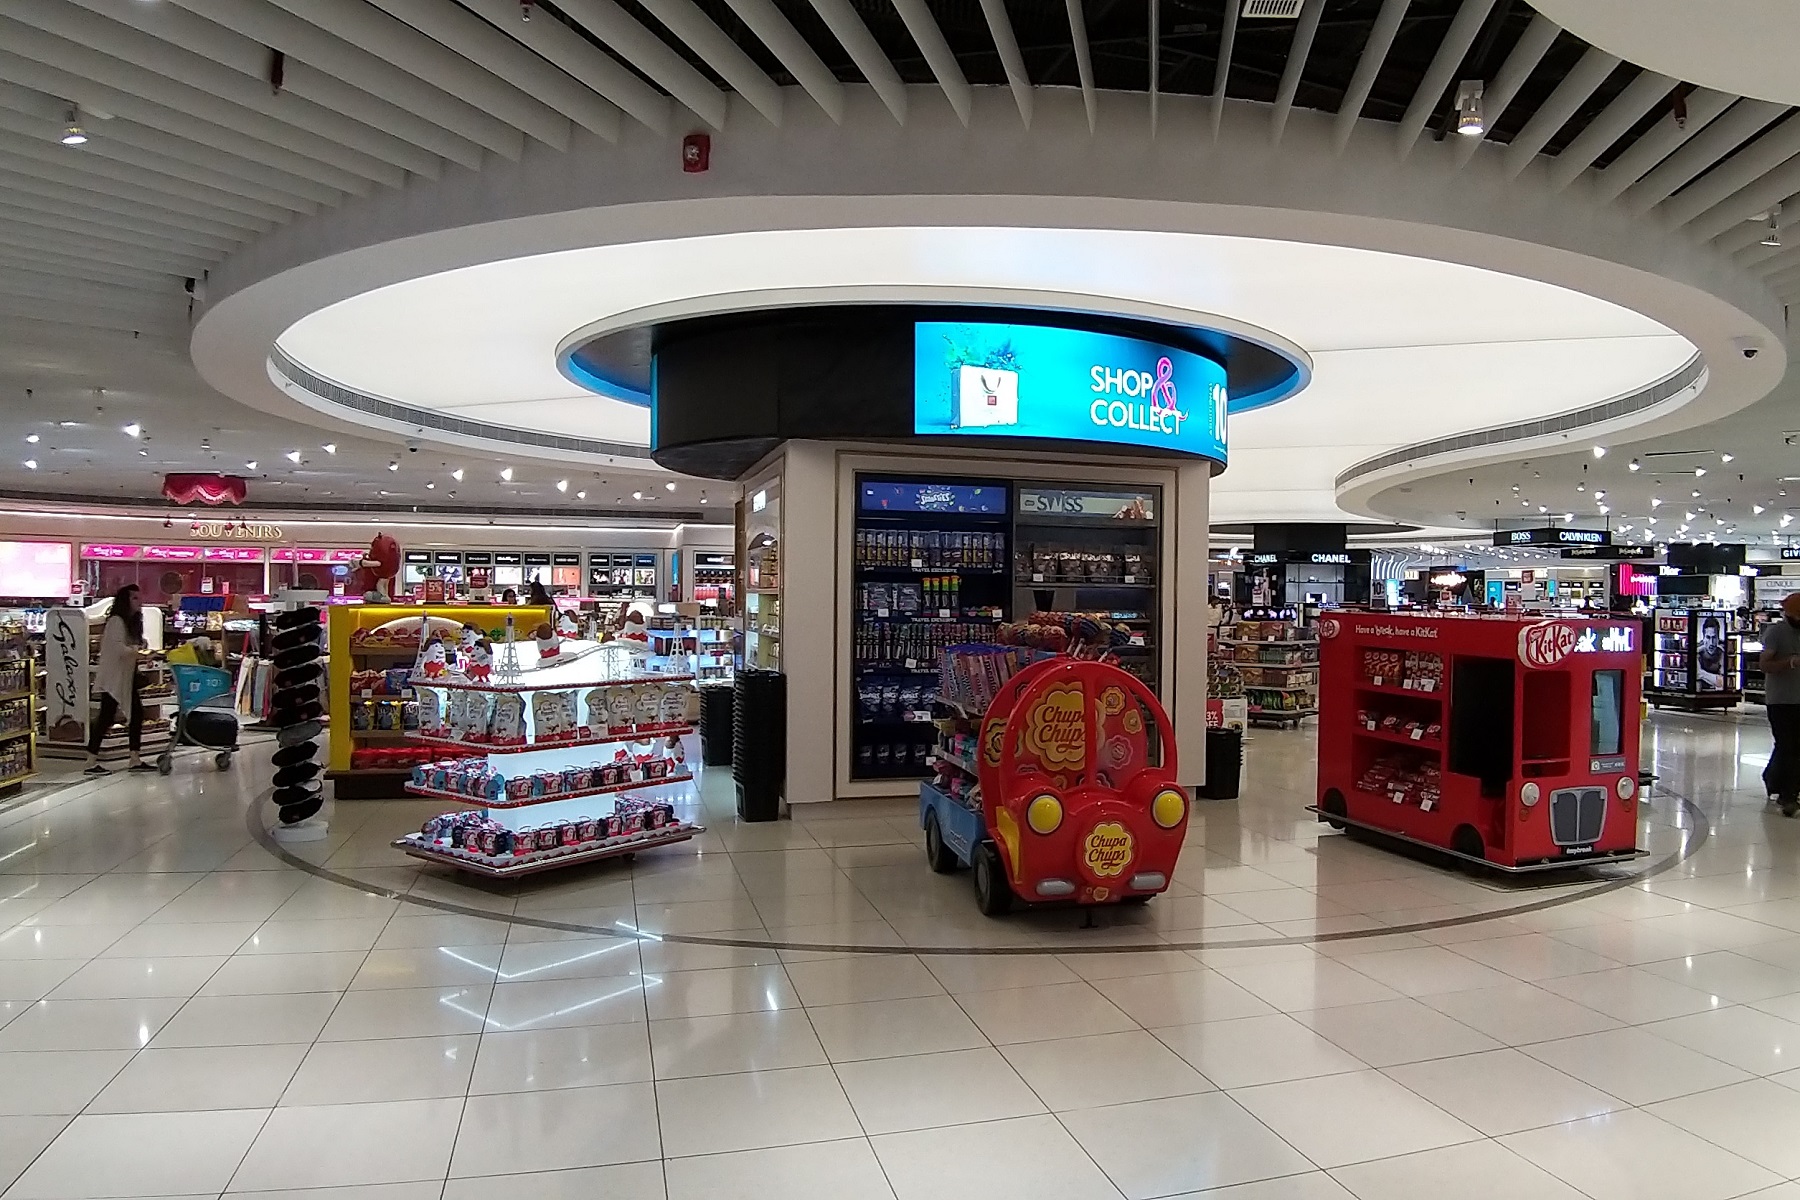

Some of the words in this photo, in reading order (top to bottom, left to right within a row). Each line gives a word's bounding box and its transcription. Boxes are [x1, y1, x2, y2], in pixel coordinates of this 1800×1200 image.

[1090, 365, 1154, 398] SHOP
[1090, 398, 1182, 436] COLLECT
[1511, 532, 1531, 541] BOSS
[1559, 531, 1584, 542] CALVIN
[1583, 532, 1602, 543] KLEIN
[1254, 554, 1278, 563] CHANEL
[1311, 553, 1351, 564] CHANEL
[1766, 580, 1794, 588] CLINIQUE
[1355, 624, 1370, 634] Have
[1395, 626, 1410, 636] have
[1530, 625, 1574, 664] KitKat
[53, 612, 79, 714] Galaxy
[1042, 705, 1085, 729] Chup
[1090, 834, 1127, 850] Chupa
[1088, 848, 1125, 870] Chups
